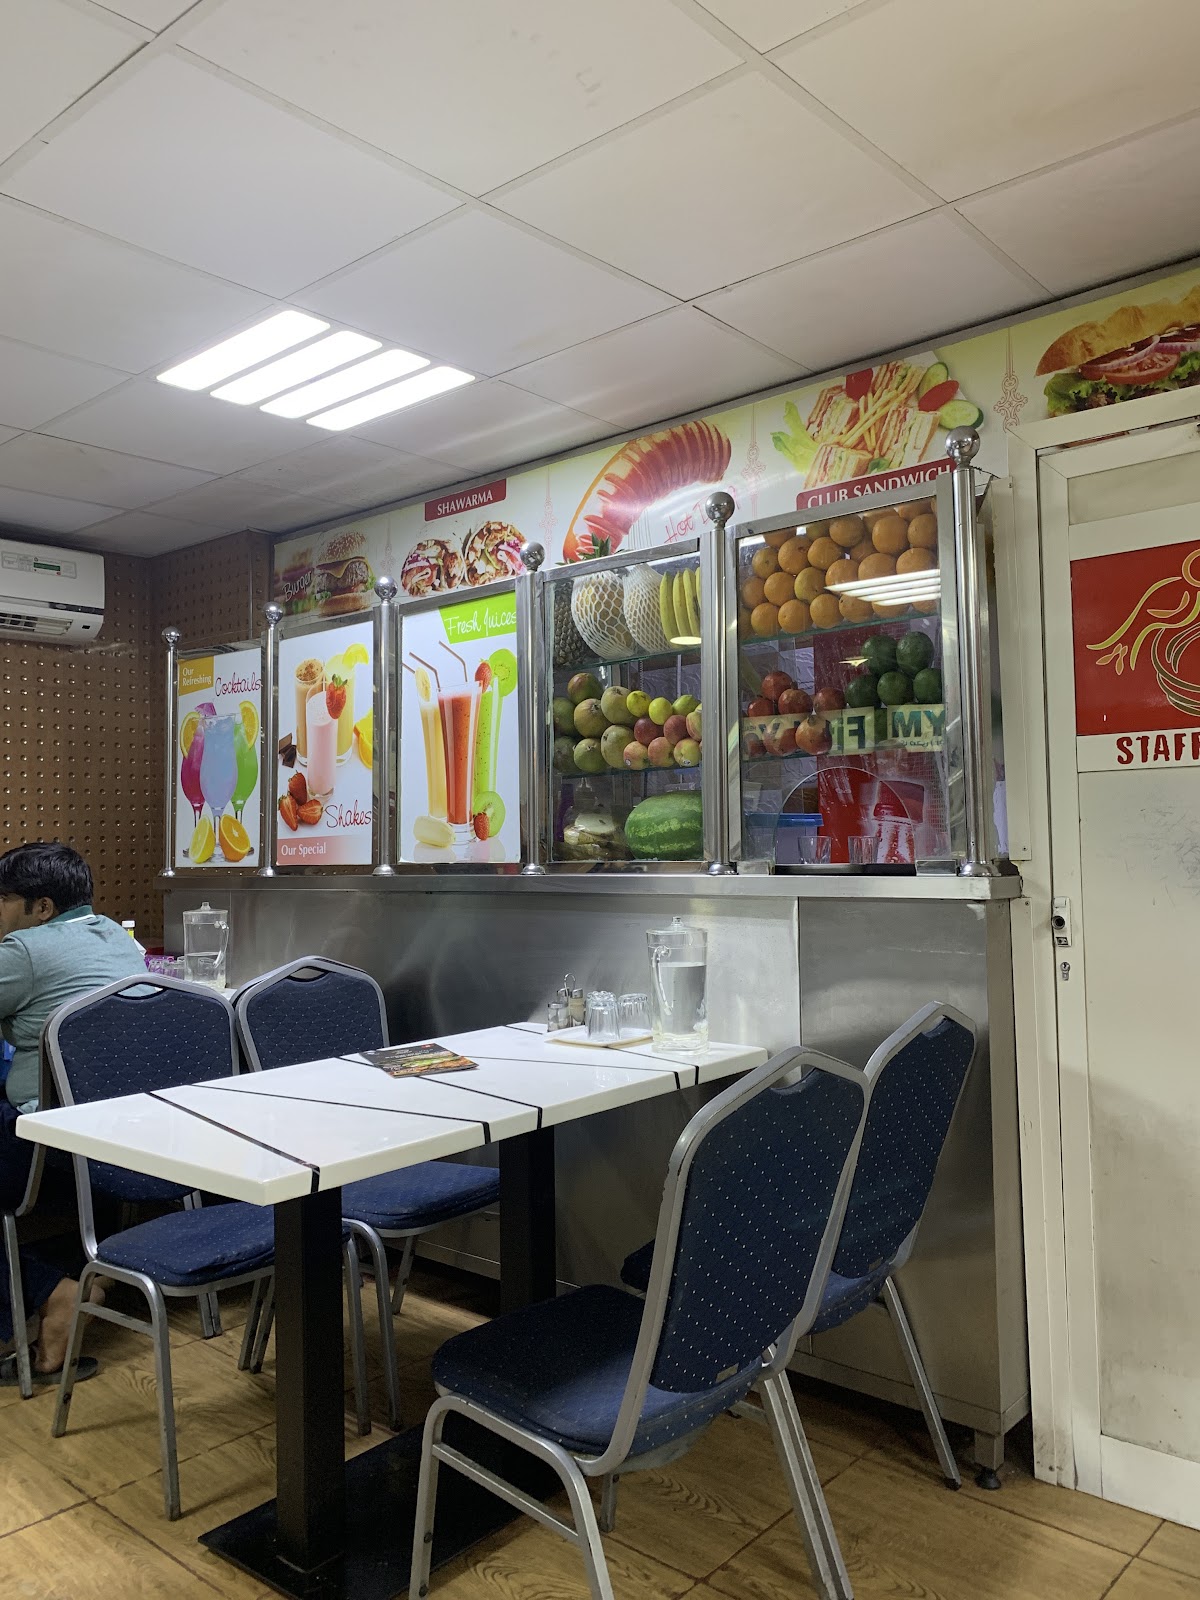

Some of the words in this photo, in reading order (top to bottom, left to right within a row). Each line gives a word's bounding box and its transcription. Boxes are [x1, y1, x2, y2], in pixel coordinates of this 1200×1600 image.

[437, 489, 493, 516] SHAWARMA
[282, 570, 312, 602] Burger
[444, 610, 482, 636] Fresh
[483, 607, 517, 637] Juices
[182, 667, 194, 677] Our
[182, 674, 212, 687] Refreshing
[215, 671, 262, 697] Cocktails
[325, 799, 372, 829] Shakes
[281, 844, 296, 856] Our
[298, 842, 327, 858] Special
